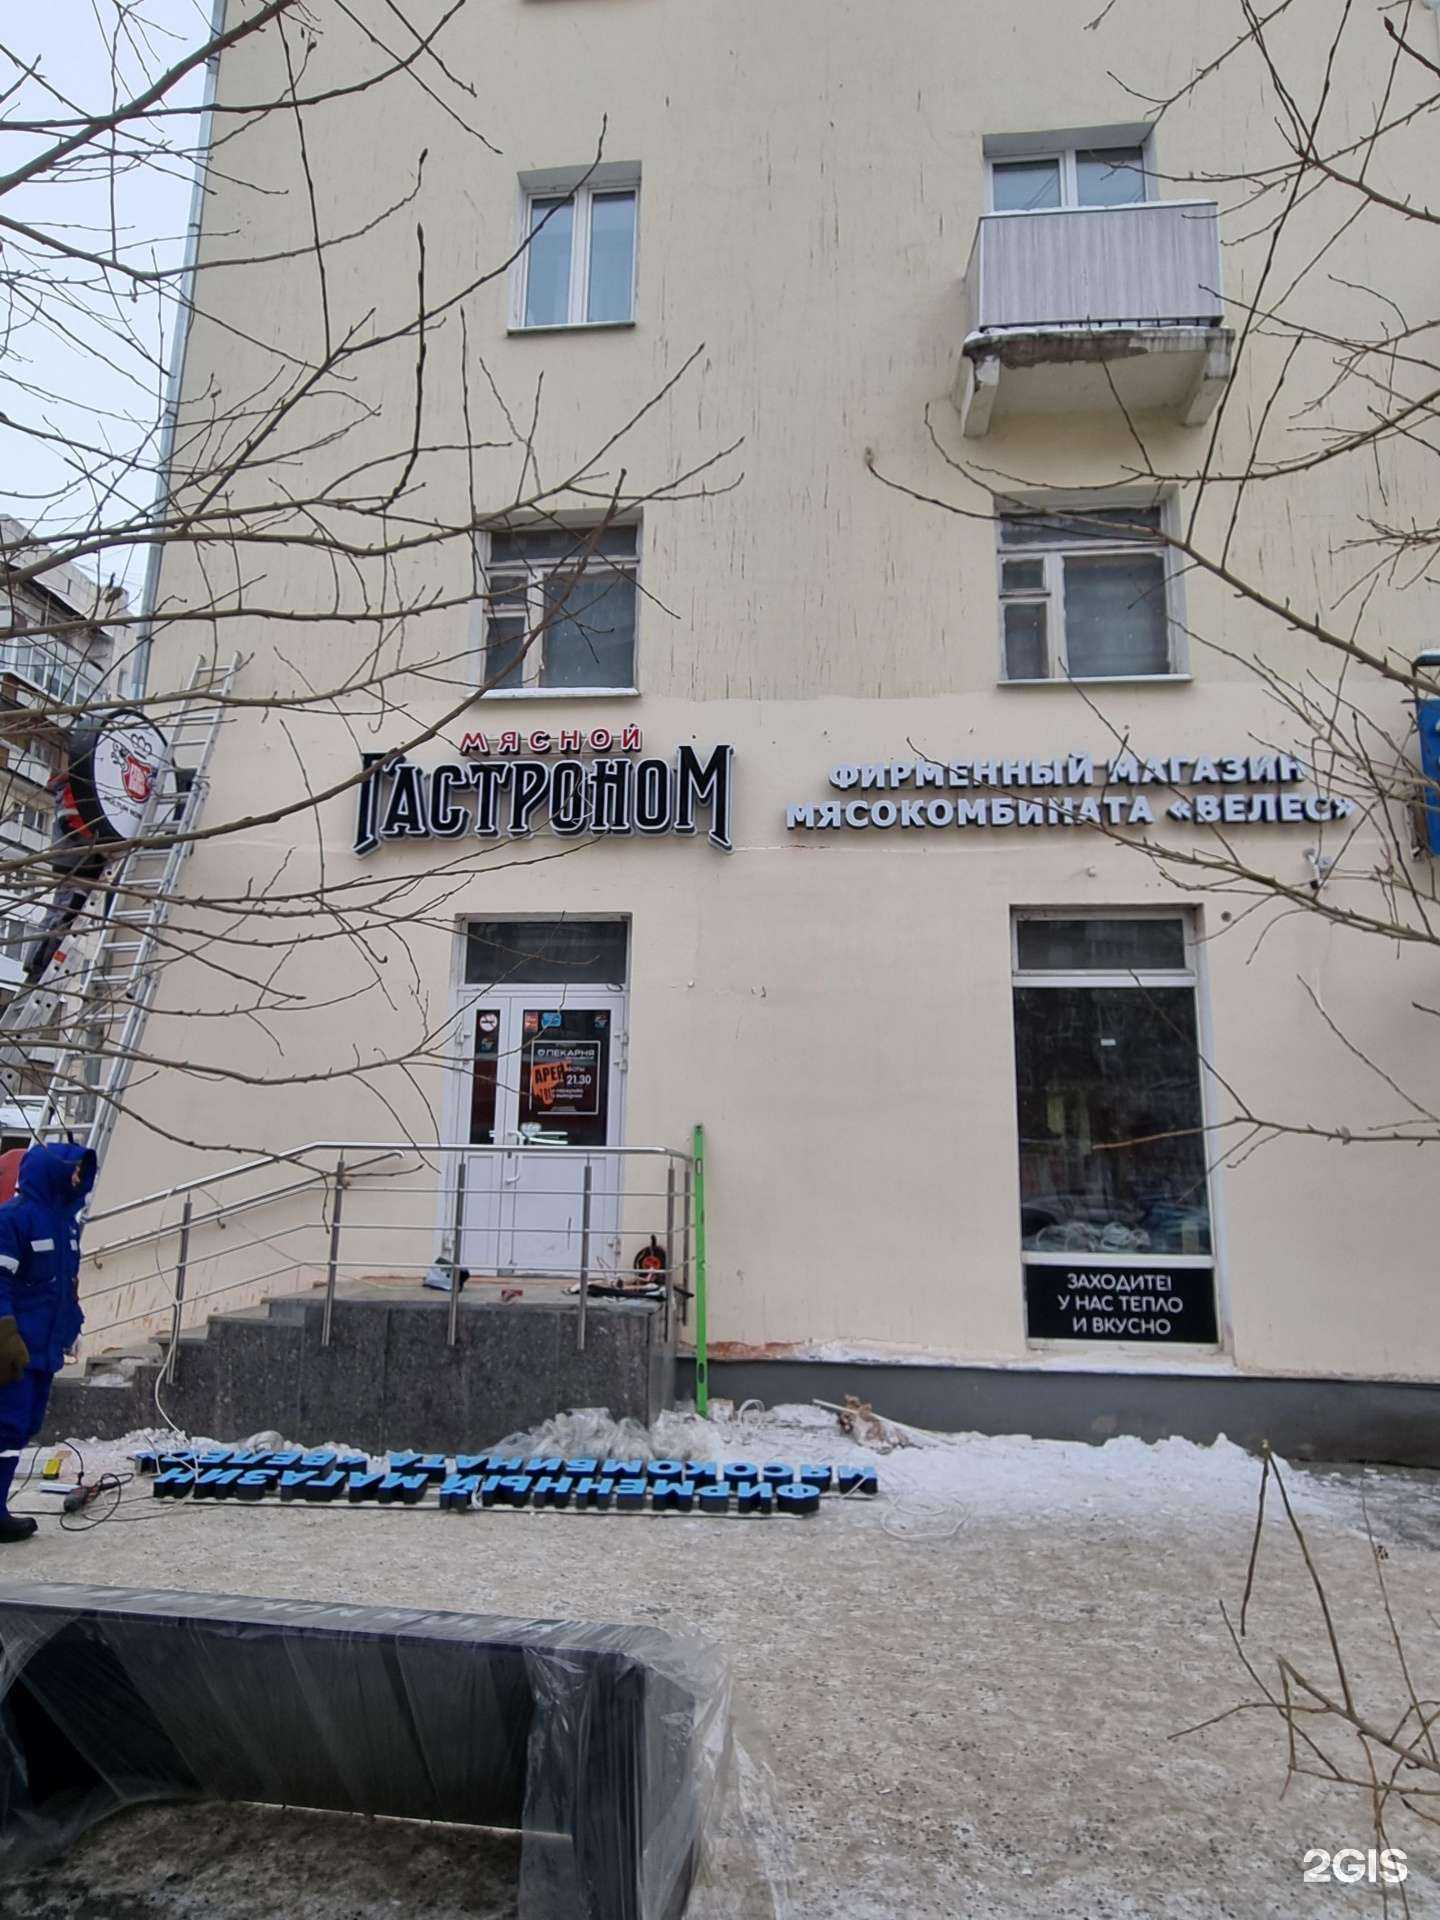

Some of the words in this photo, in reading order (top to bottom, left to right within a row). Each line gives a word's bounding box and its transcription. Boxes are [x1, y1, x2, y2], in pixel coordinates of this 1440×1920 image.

[459, 723, 643, 755] МЯСНОЙ
[829, 750, 1094, 790] ФИРМЕННЫЙ
[1109, 754, 1306, 785] МАГАЗИН
[353, 744, 735, 857] ГАСТРОНОМ
[786, 795, 1157, 829] МЯСОКОМБИНАТА
[1067, 1273, 1172, 1292] ЗАХОДИТЕ!
[1058, 1295, 1070, 1311] У
[1076, 1296, 1114, 1312] НАС
[1118, 1297, 1183, 1313] ТЕПЛО
[1073, 1318, 1087, 1332] И
[1092, 1318, 1171, 1335] ВКУСНО
